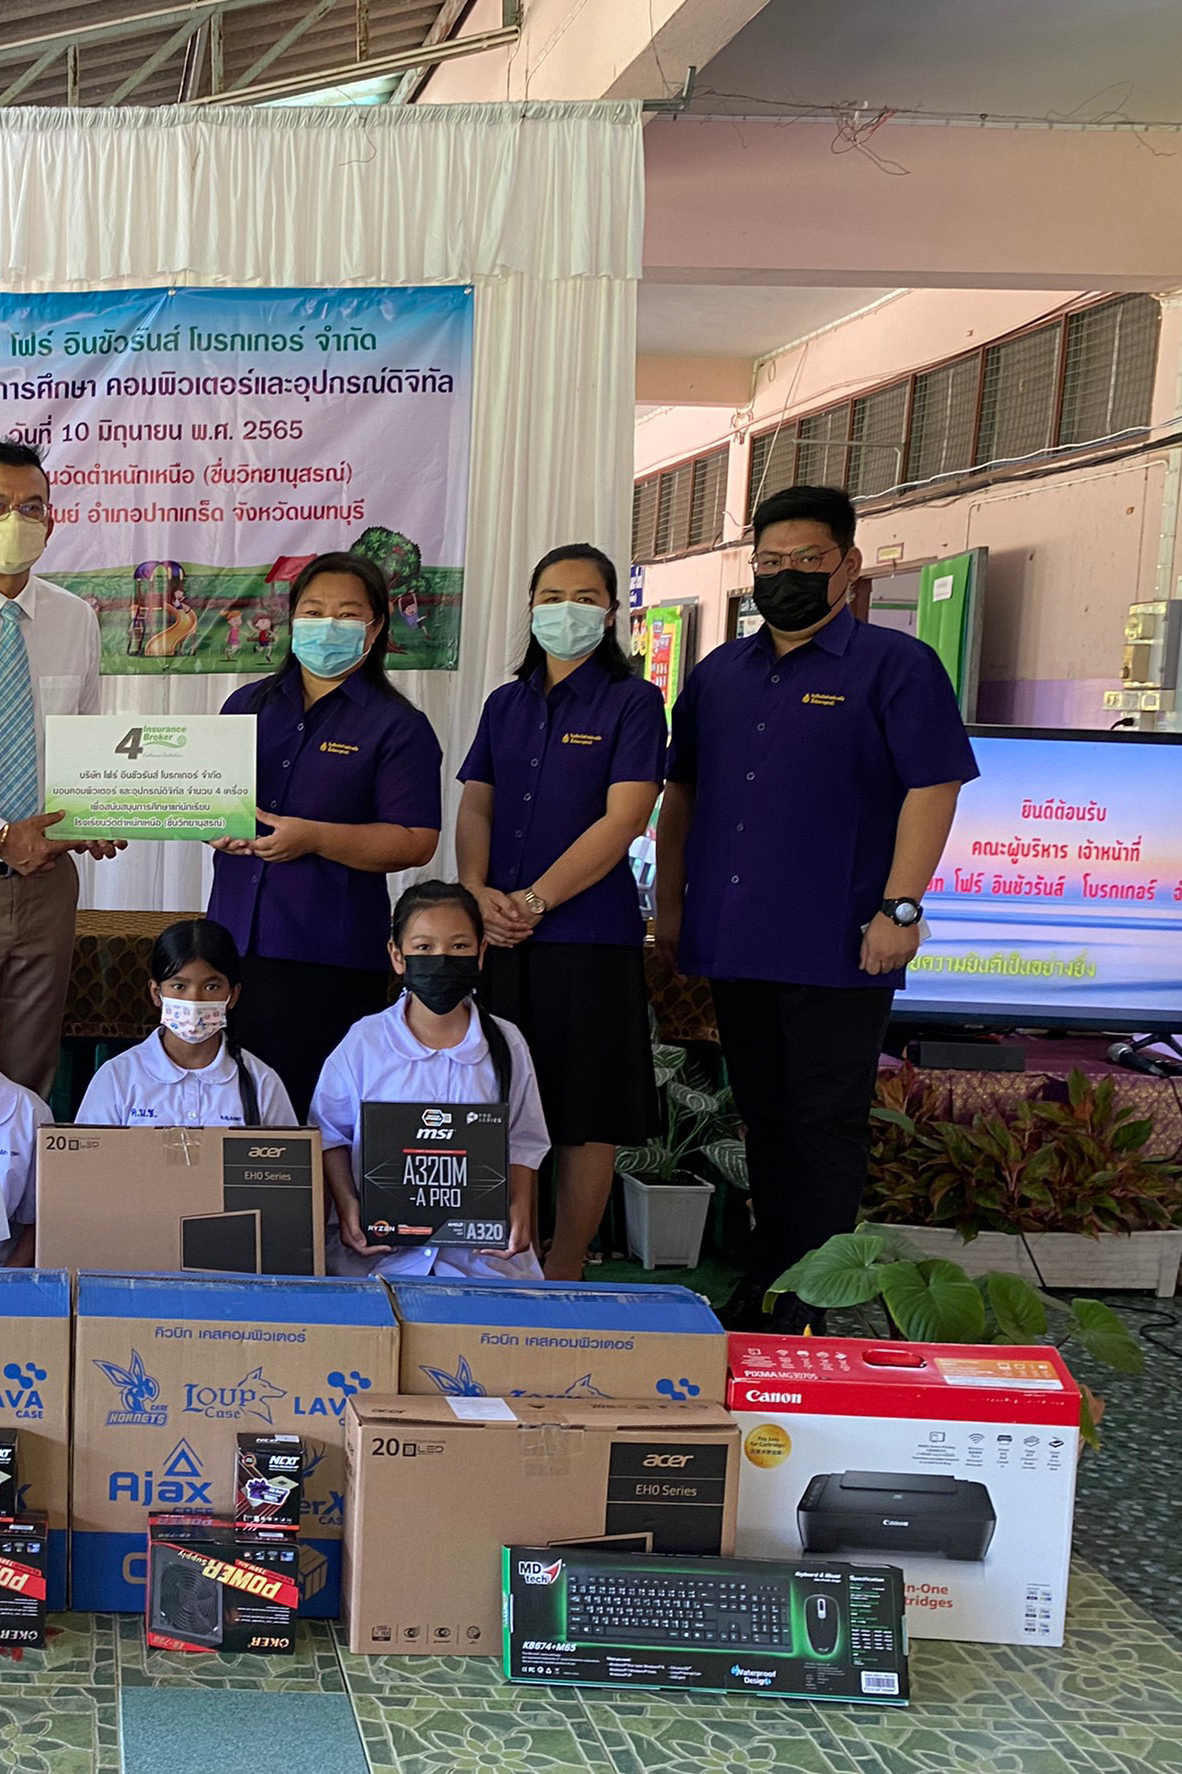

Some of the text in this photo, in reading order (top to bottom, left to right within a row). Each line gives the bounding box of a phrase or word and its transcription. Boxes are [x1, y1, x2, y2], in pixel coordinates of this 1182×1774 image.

[10, 329, 54, 357] โฟร์
[189, 325, 305, 352] โบรกเกอร์
[314, 325, 377, 352] จำกัด
[106, 366, 454, 403] คอมพิวเตอร์และอุปกรณ์ดิจิทัล
[62, 421, 90, 442] 10
[98, 419, 182, 448] มิถุนายน
[192, 421, 234, 442] พ.ศ.
[243, 420, 303, 441] 2565
[88, 500, 224, 523] อำเภอปากเกร็ด
[232, 498, 365, 525] จังหวัดนนทบุรี
[143, 725, 187, 733] Insurance
[114, 727, 143, 759] 4
[143, 733, 173, 741] Broker
[215, 787, 221, 795] 4
[1021, 798, 1107, 822] ยินดีต้อนรับ
[971, 835, 1142, 865] คณะผู้บริหาร เจ้าหน้าที่
[954, 867, 984, 894] โฟร์
[1082, 872, 1158, 901] โบรกเกอร์
[907, 948, 1096, 978] ยความยินดีเป็นอย่างยิ่ง
[416, 1128, 455, 1140] msi
[46, 1136, 66, 1150] 20
[248, 1146, 287, 1158] acer
[264, 1171, 292, 1182] Series
[402, 1155, 467, 1187] A320M
[409, 1188, 461, 1208] -A PRO
[367, 1224, 395, 1233] RYZEN
[467, 1222, 503, 1241] A320
[155, 1326, 306, 1343] คิวบิก เคสคอมพิวเตอร์
[480, 1332, 634, 1350] คิวบิก เคสคอมพิวเตอร์
[746, 1389, 802, 1404] Canon
[204, 1406, 241, 1419] Case
[294, 1396, 347, 1415] LAV
[15, 1410, 43, 1419] CASE
[108, 1412, 166, 1425] HORNETS
[371, 1437, 399, 1456] 20
[642, 1453, 694, 1468] acer
[109, 1471, 213, 1506] Ajax
[661, 1485, 698, 1497] Series
[319, 1516, 343, 1525] CAS
[178, 1549, 208, 1566] Supply
[519, 1561, 542, 1574] MD
[202, 1559, 283, 1599] POWER
[524, 1572, 550, 1585] tech
[849, 1575, 885, 1583] Specification
[905, 1584, 949, 1595] n-One
[904, 1596, 954, 1610] tridges
[0, 1629, 38, 1641] OKER
[250, 1637, 290, 1648] OKER
